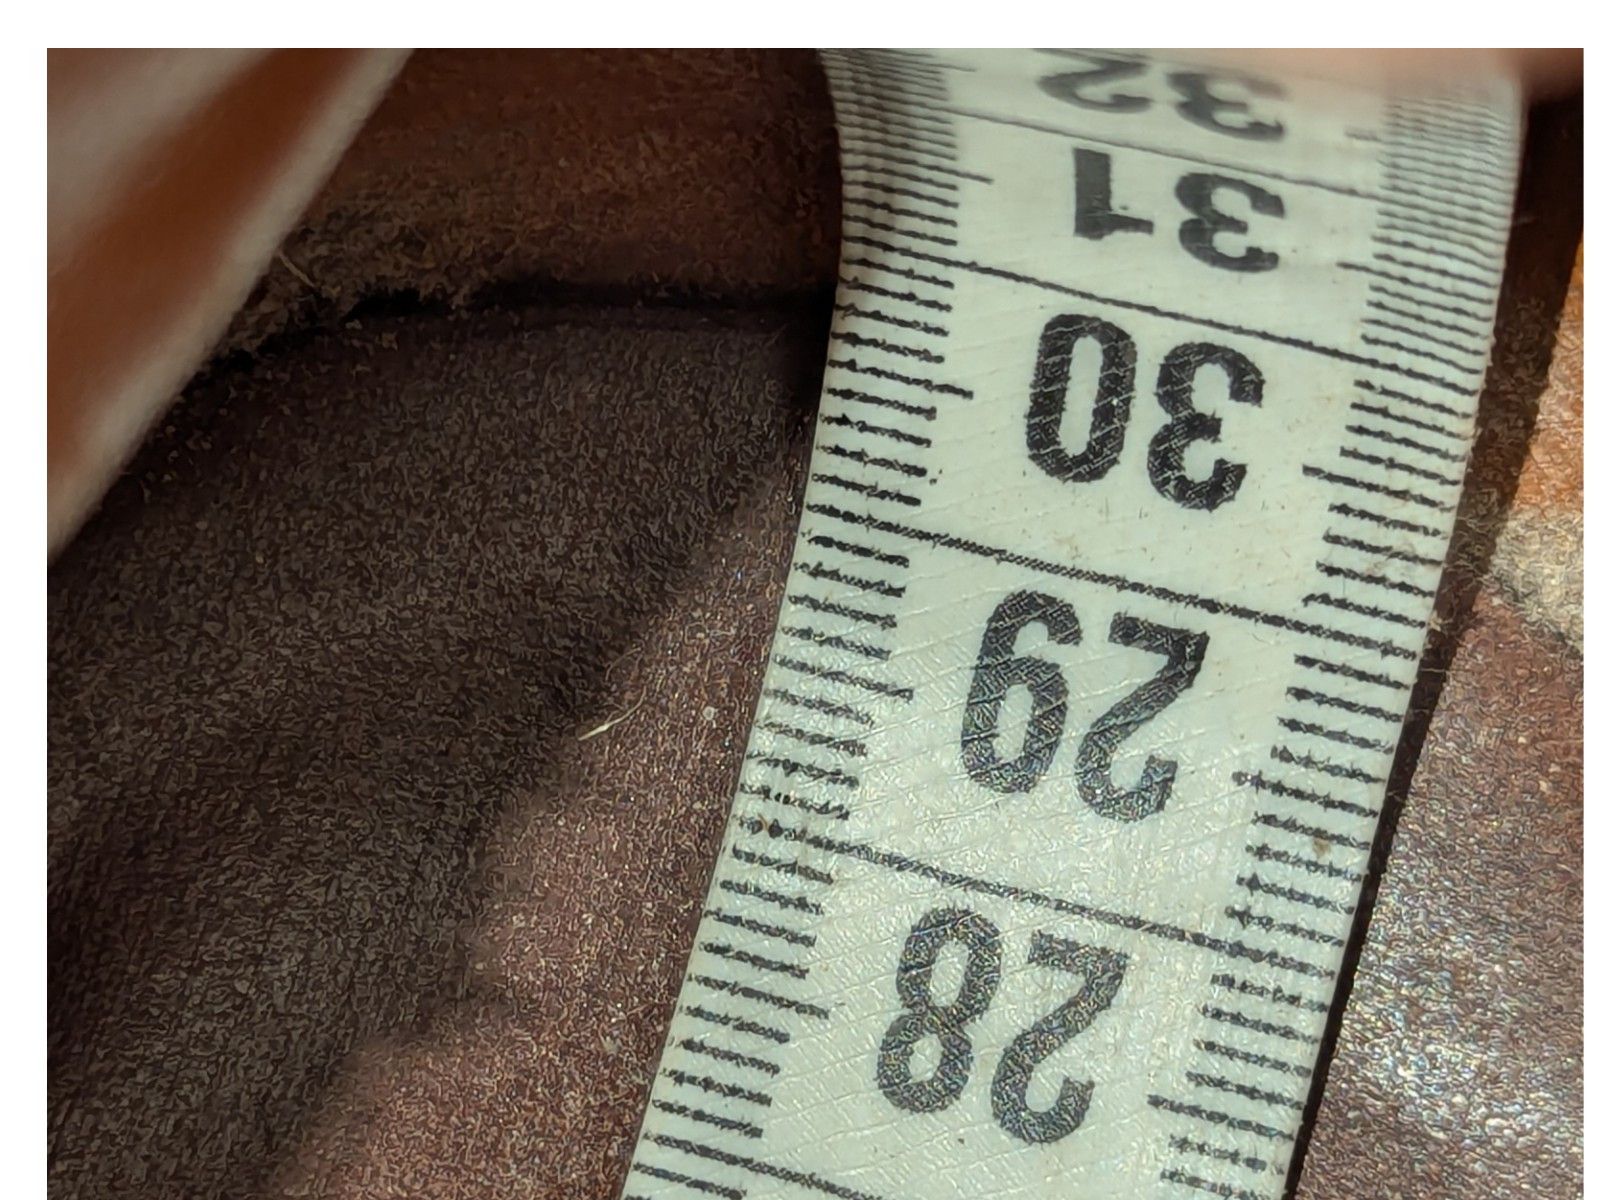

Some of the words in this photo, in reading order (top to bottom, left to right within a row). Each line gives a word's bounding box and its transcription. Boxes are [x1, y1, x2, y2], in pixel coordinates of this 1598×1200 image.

[1036, 48, 1287, 141] 32
[1072, 147, 1287, 273] 31
[1024, 313, 1266, 513] 30
[958, 588, 1211, 824] 29
[876, 906, 1131, 1145] 28
